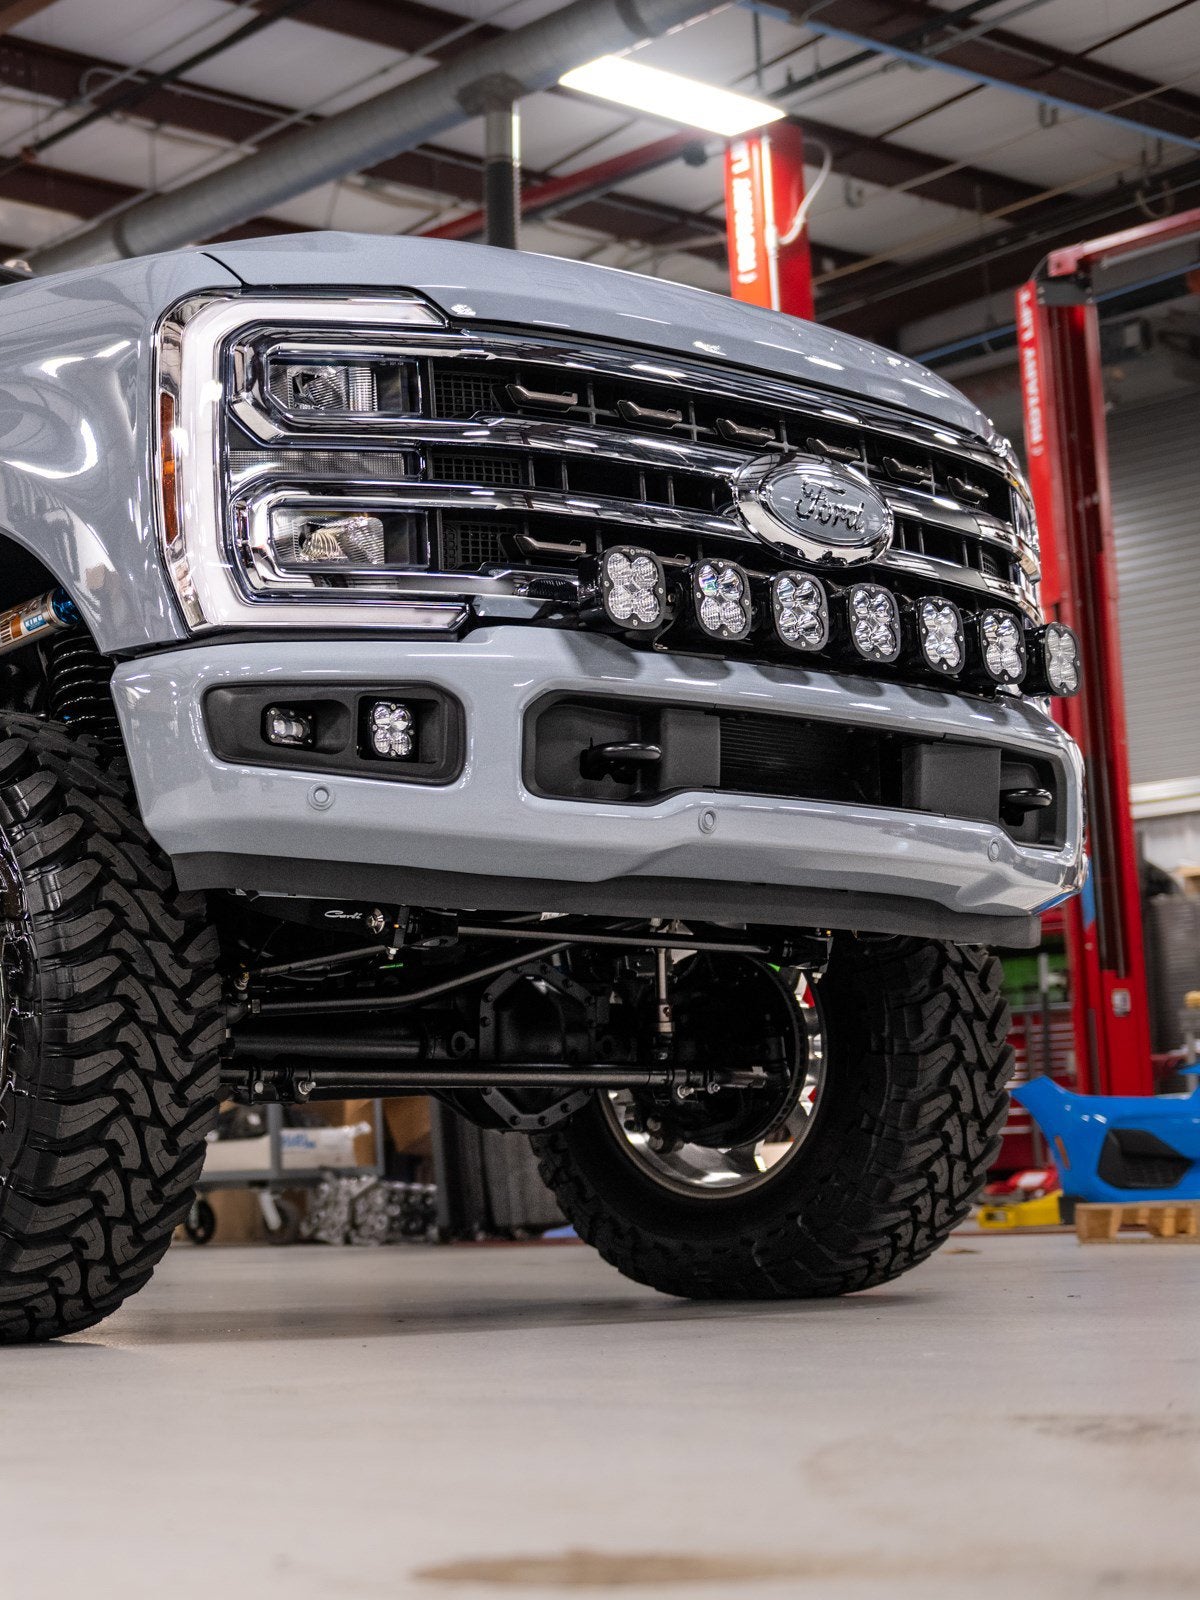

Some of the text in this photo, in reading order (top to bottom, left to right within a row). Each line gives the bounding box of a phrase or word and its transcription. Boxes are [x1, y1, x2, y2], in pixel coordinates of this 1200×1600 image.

[1018, 289, 1043, 444] ROTARY LIFT
[794, 474, 866, 534] Ford
